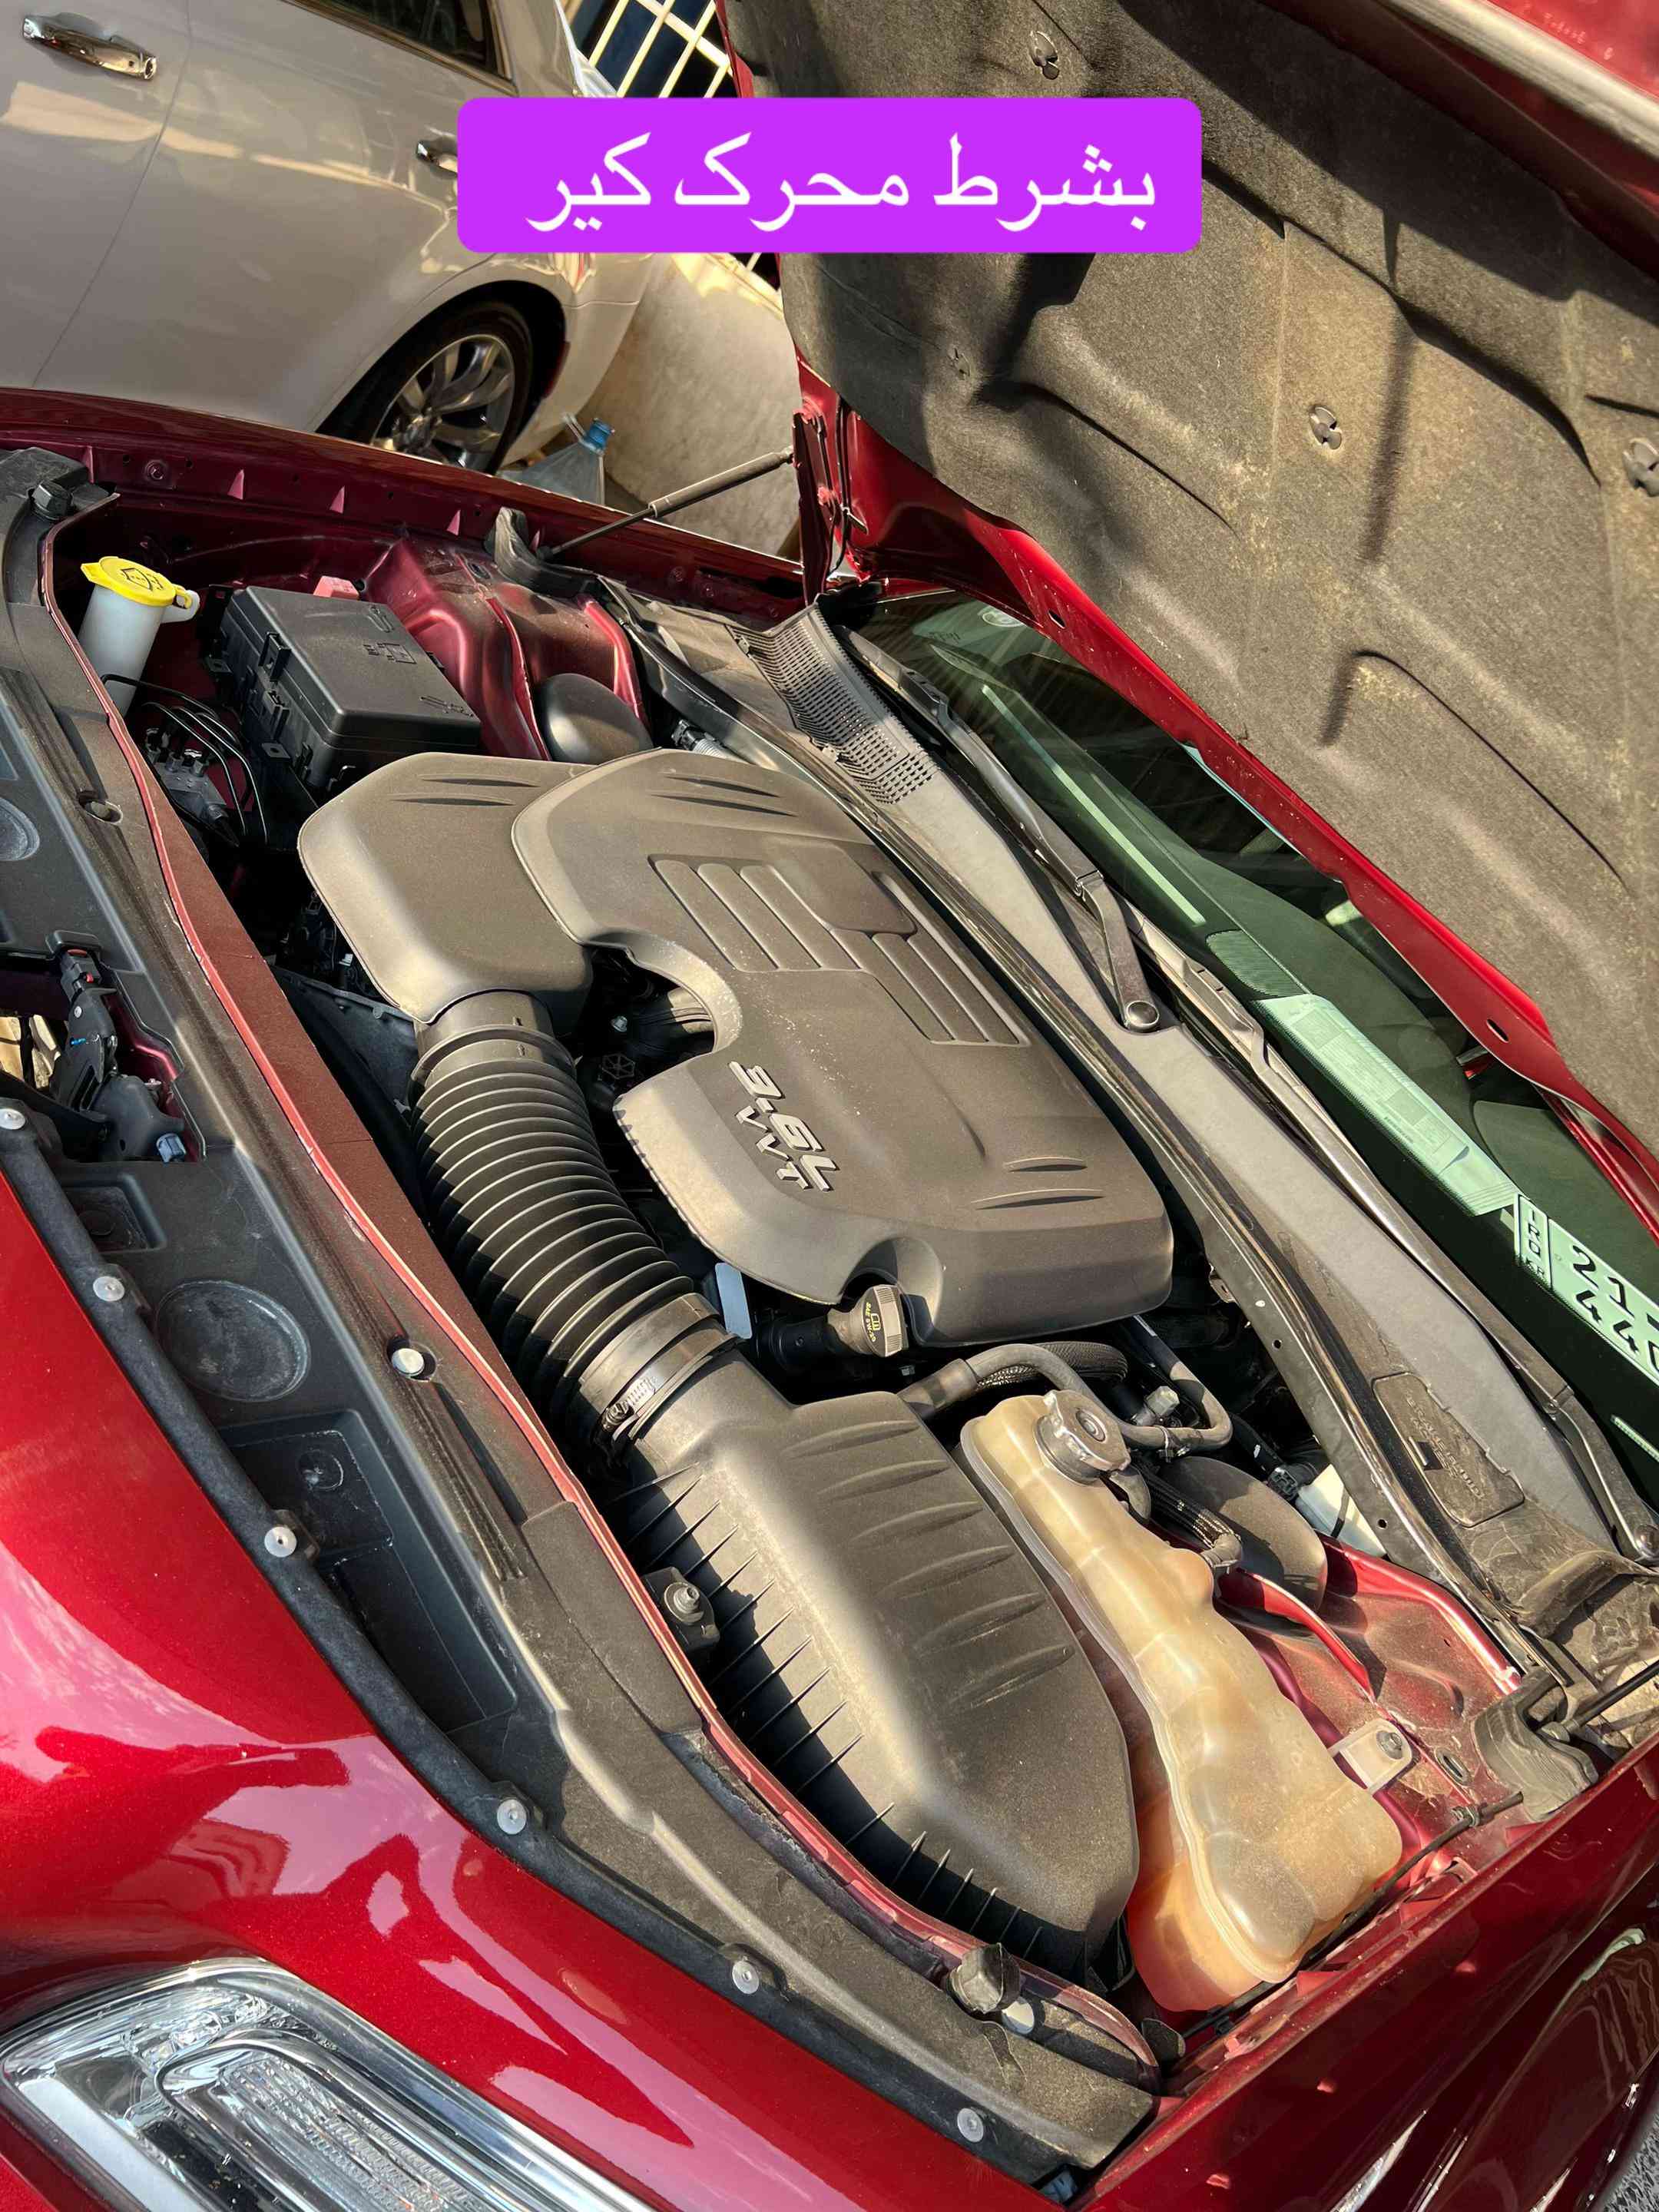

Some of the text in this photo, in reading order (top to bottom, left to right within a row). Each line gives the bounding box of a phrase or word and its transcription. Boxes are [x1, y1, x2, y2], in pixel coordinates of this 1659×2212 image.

[729, 1061, 839, 1191] 3.6L
[735, 1105, 812, 1190] VVT
[1572, 1245, 1634, 1317] 21
